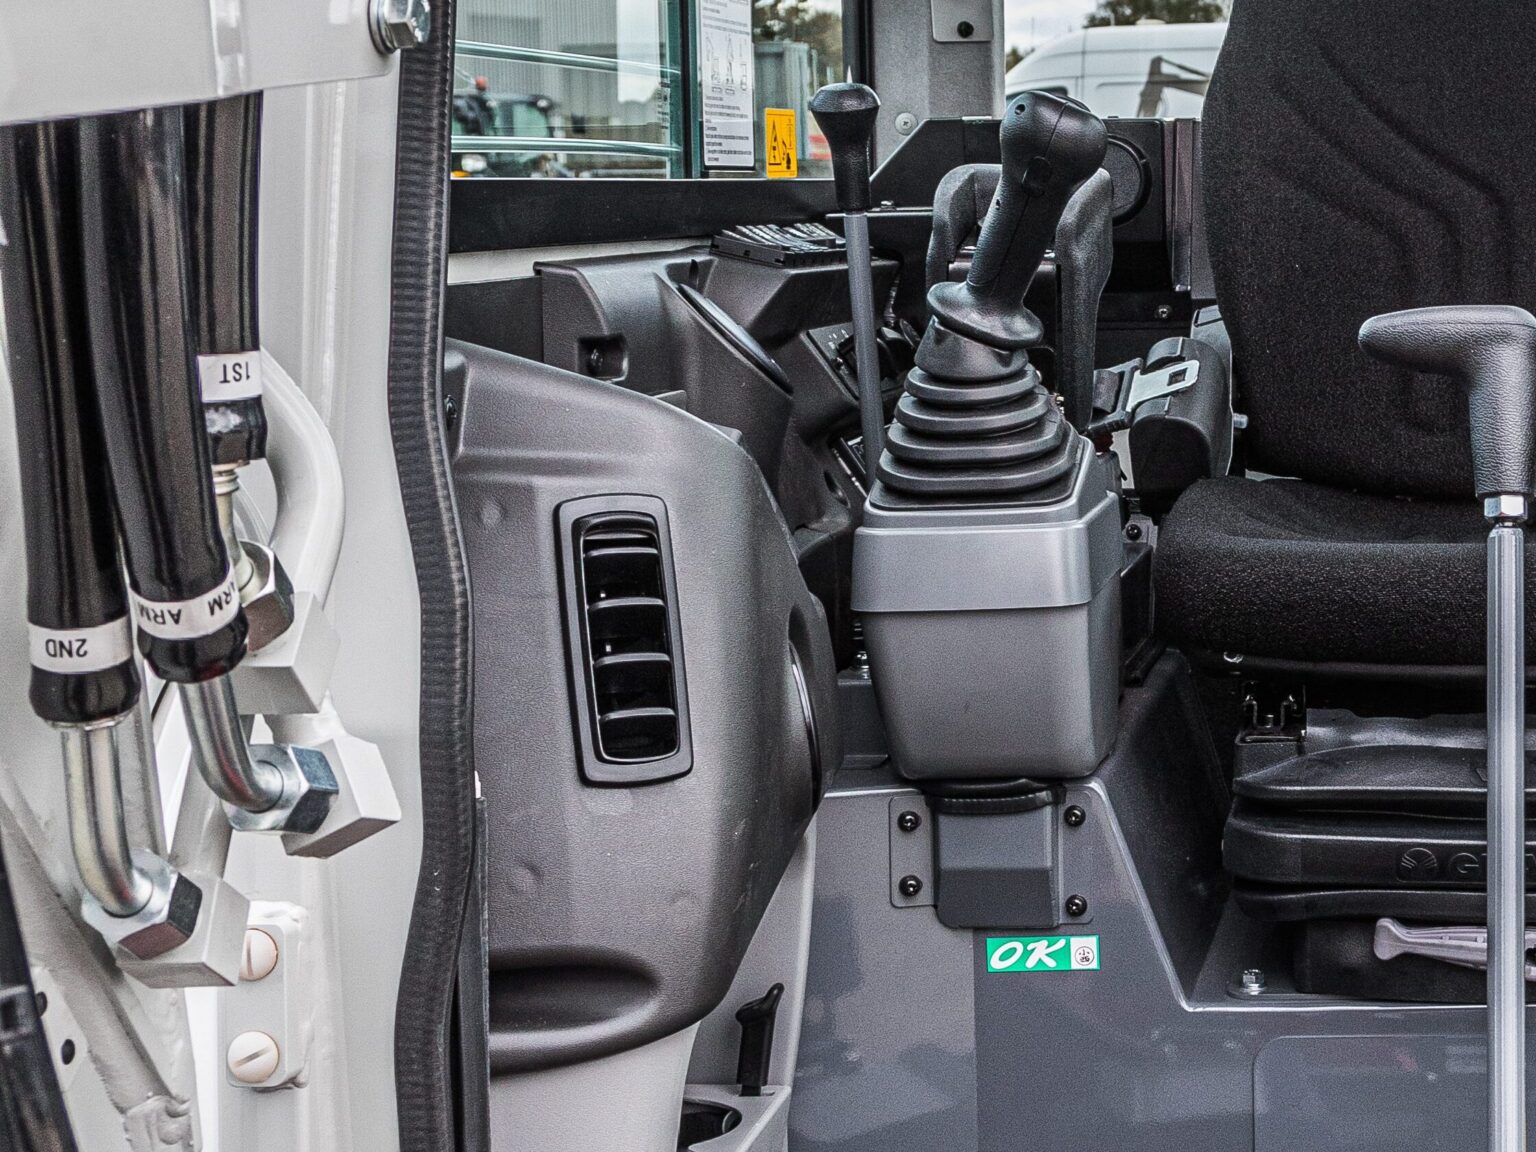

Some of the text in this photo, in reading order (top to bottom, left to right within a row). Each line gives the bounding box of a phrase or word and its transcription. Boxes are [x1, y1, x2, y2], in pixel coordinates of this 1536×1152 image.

[219, 361, 250, 384] 1ST
[45, 638, 88, 658] 2ND
[989, 938, 1067, 970] OK
